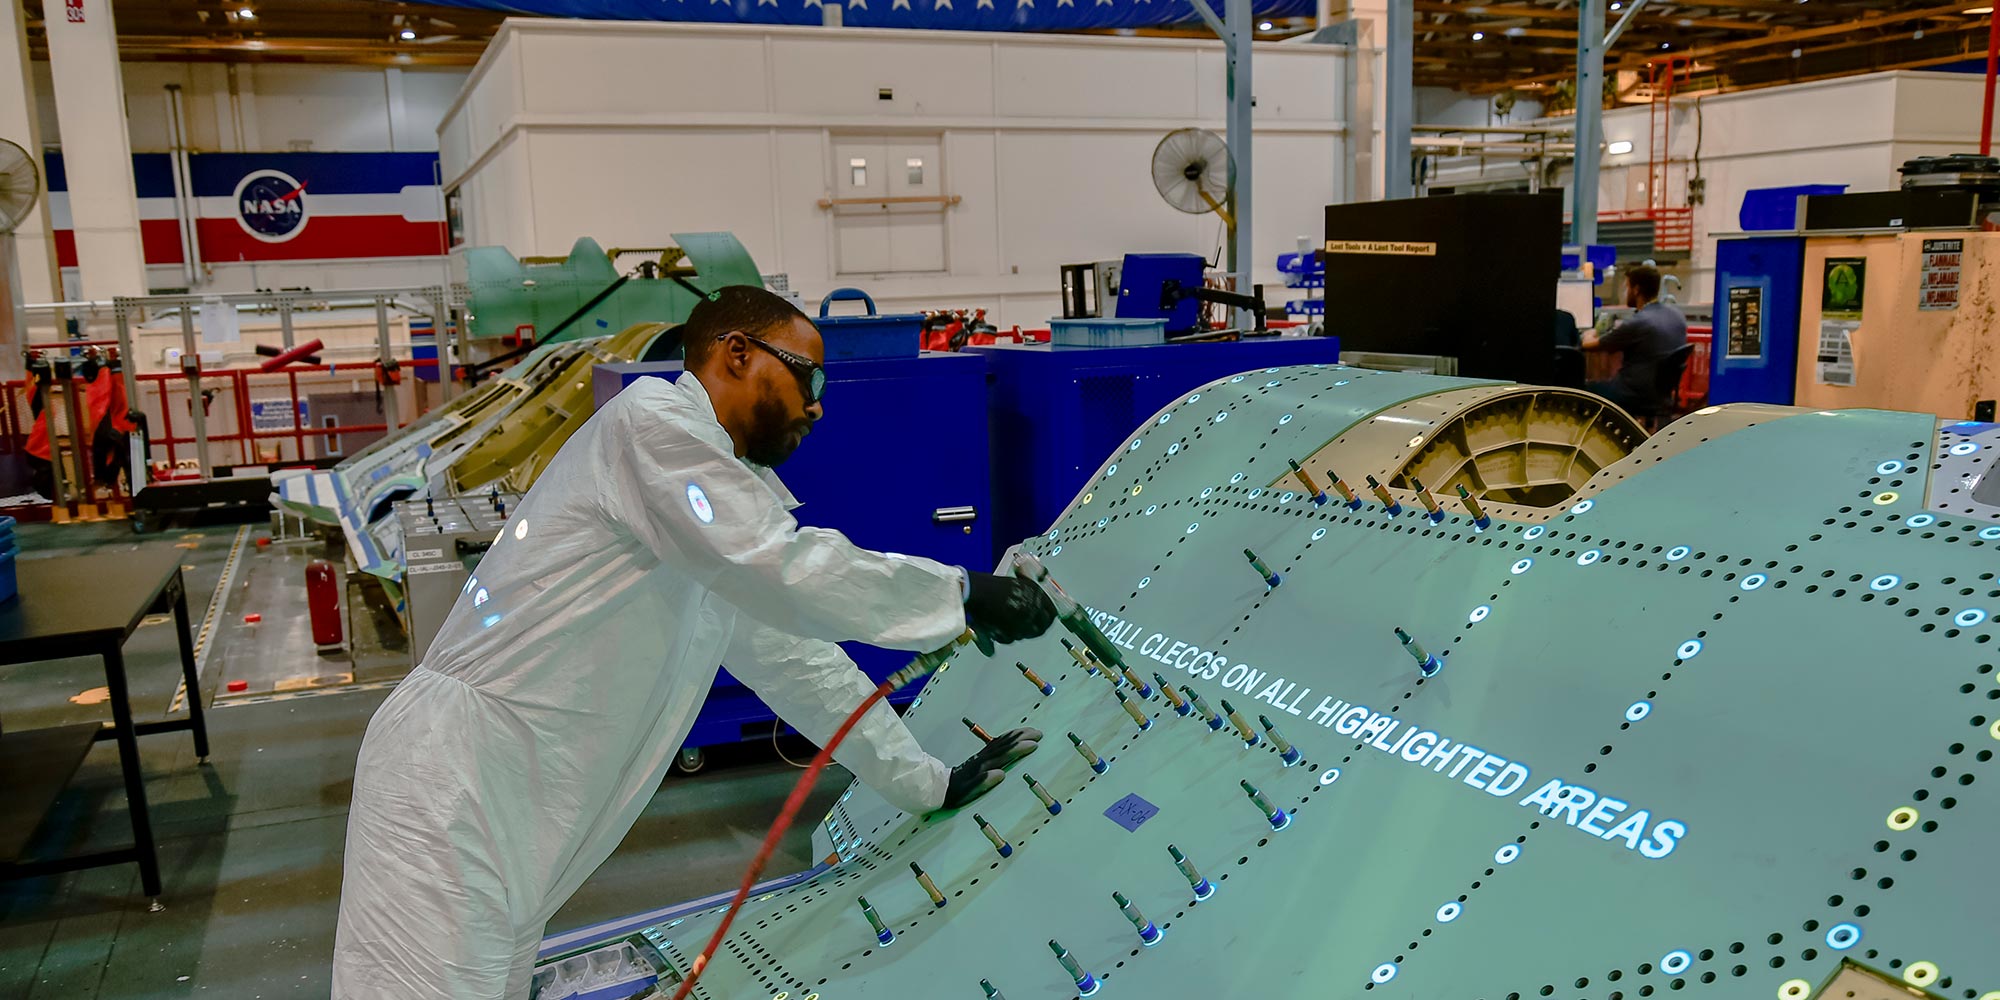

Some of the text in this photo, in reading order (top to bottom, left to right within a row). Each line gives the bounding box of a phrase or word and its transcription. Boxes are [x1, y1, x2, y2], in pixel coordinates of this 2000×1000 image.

[243, 198, 301, 215] NASA
[1345, 243, 1361, 251] Tools
[1406, 245, 1430, 253] Report
[1930, 254, 1961, 267] FLAMMABLE
[1084, 606, 1687, 860] NSTALL CLECOS ON ALL HIGHLIGHTED AREAS
[1112, 798, 1151, 824] AX-06
